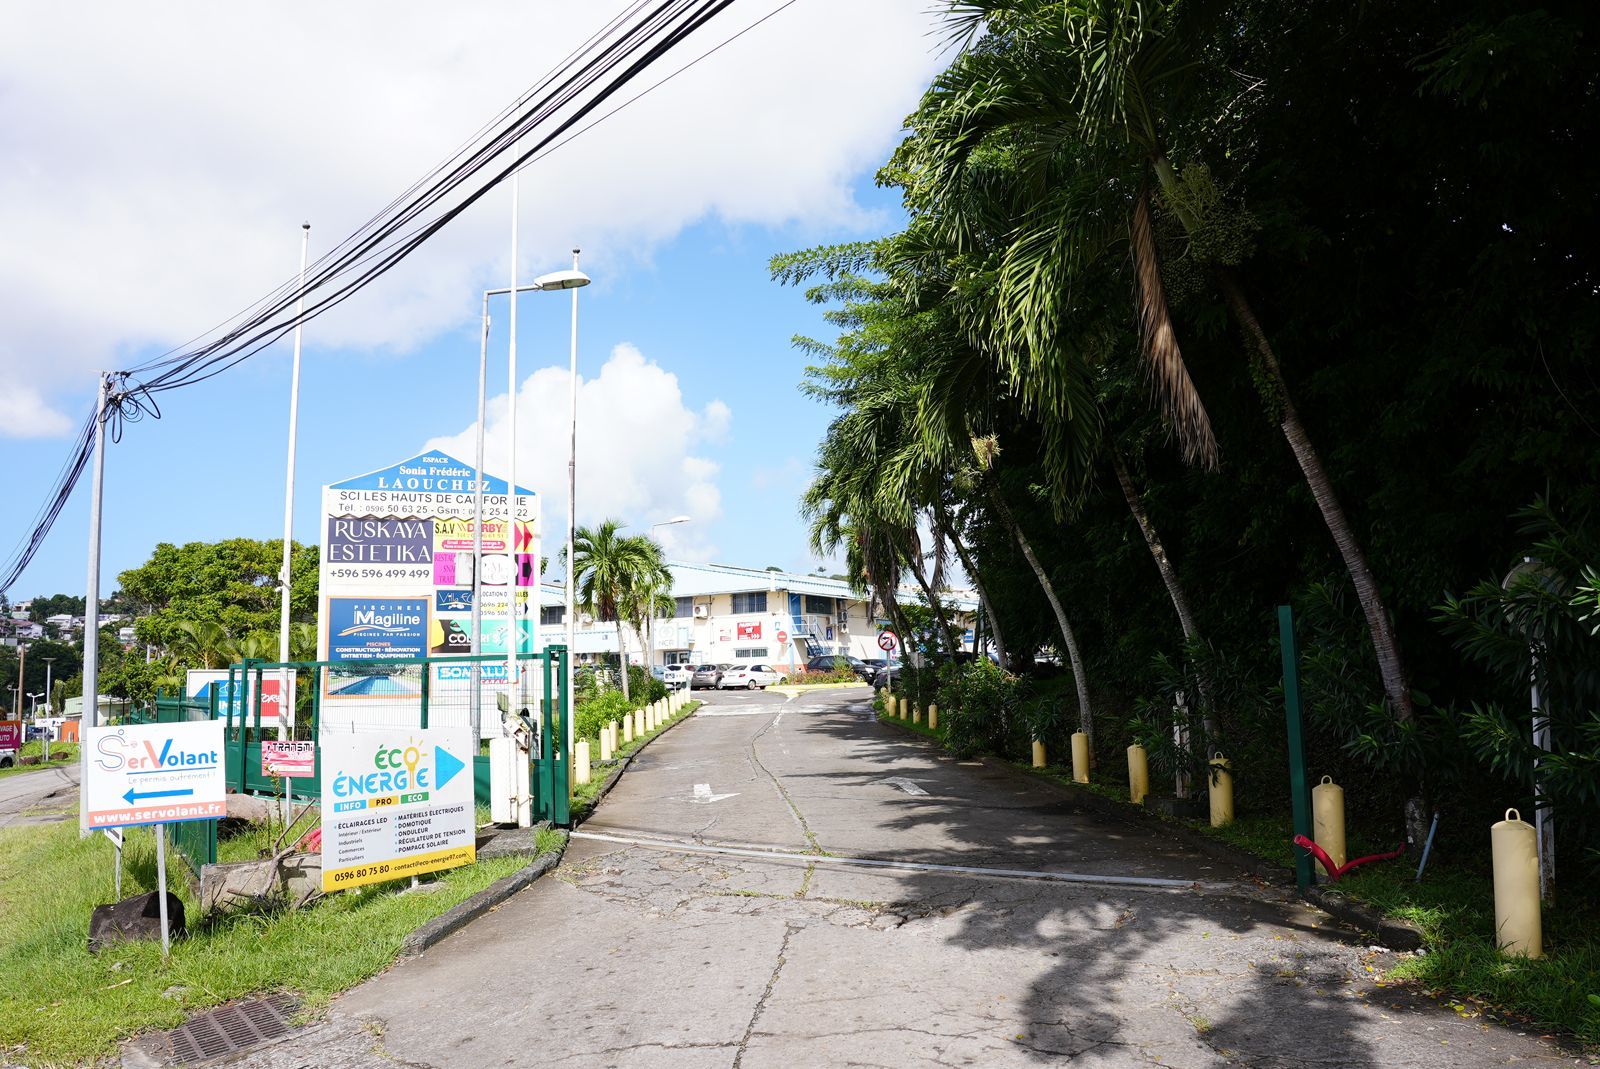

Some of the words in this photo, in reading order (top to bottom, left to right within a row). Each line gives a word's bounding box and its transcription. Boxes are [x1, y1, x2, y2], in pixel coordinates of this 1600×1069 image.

[400, 466, 426, 475] Sonia
[430, 466, 471, 477] Frédéric
[378, 477, 491, 492] LAOUCHEZ
[340, 491, 360, 500] SCI
[364, 492, 387, 501] LES
[392, 493, 432, 502] HAUTS
[436, 494, 452, 503] DE
[456, 495, 526, 505] CAFORIE
[437, 506, 460, 514] Gsm
[335, 520, 427, 542] RUSKAYA
[434, 522, 455, 534] S.A.V
[467, 523, 503, 533] DRBY
[330, 544, 431, 562] ESTETIKA
[330, 569, 359, 578] +596
[362, 569, 383, 578] 596
[385, 569, 406, 578] 499
[409, 570, 430, 578] 499
[354, 610, 420, 627] Magiline
[94, 729, 218, 772] SerVolant
[374, 744, 420, 770] ÉCO
[140, 776, 167, 784] permis
[333, 768, 428, 797] ÉNERGIE
[340, 802, 361, 810] INFO
[376, 798, 392, 806] PRO
[94, 804, 221, 824] www.servolant.fr
[398, 811, 428, 820] MATÉRIELS
[338, 819, 375, 829] ÉCLAIRAGES
[398, 819, 431, 829] DOMOTIQUE
[398, 827, 428, 837] ONDULEUR
[443, 829, 466, 837] TENSION
[398, 844, 425, 853] POMPAGE
[426, 839, 448, 848] SOLAIRE
[335, 871, 354, 882] 0596
[357, 869, 366, 878] 80
[369, 867, 378, 875] 75
[380, 865, 389, 873] 80
[394, 853, 466, 871] contact@eco-energie97.com
